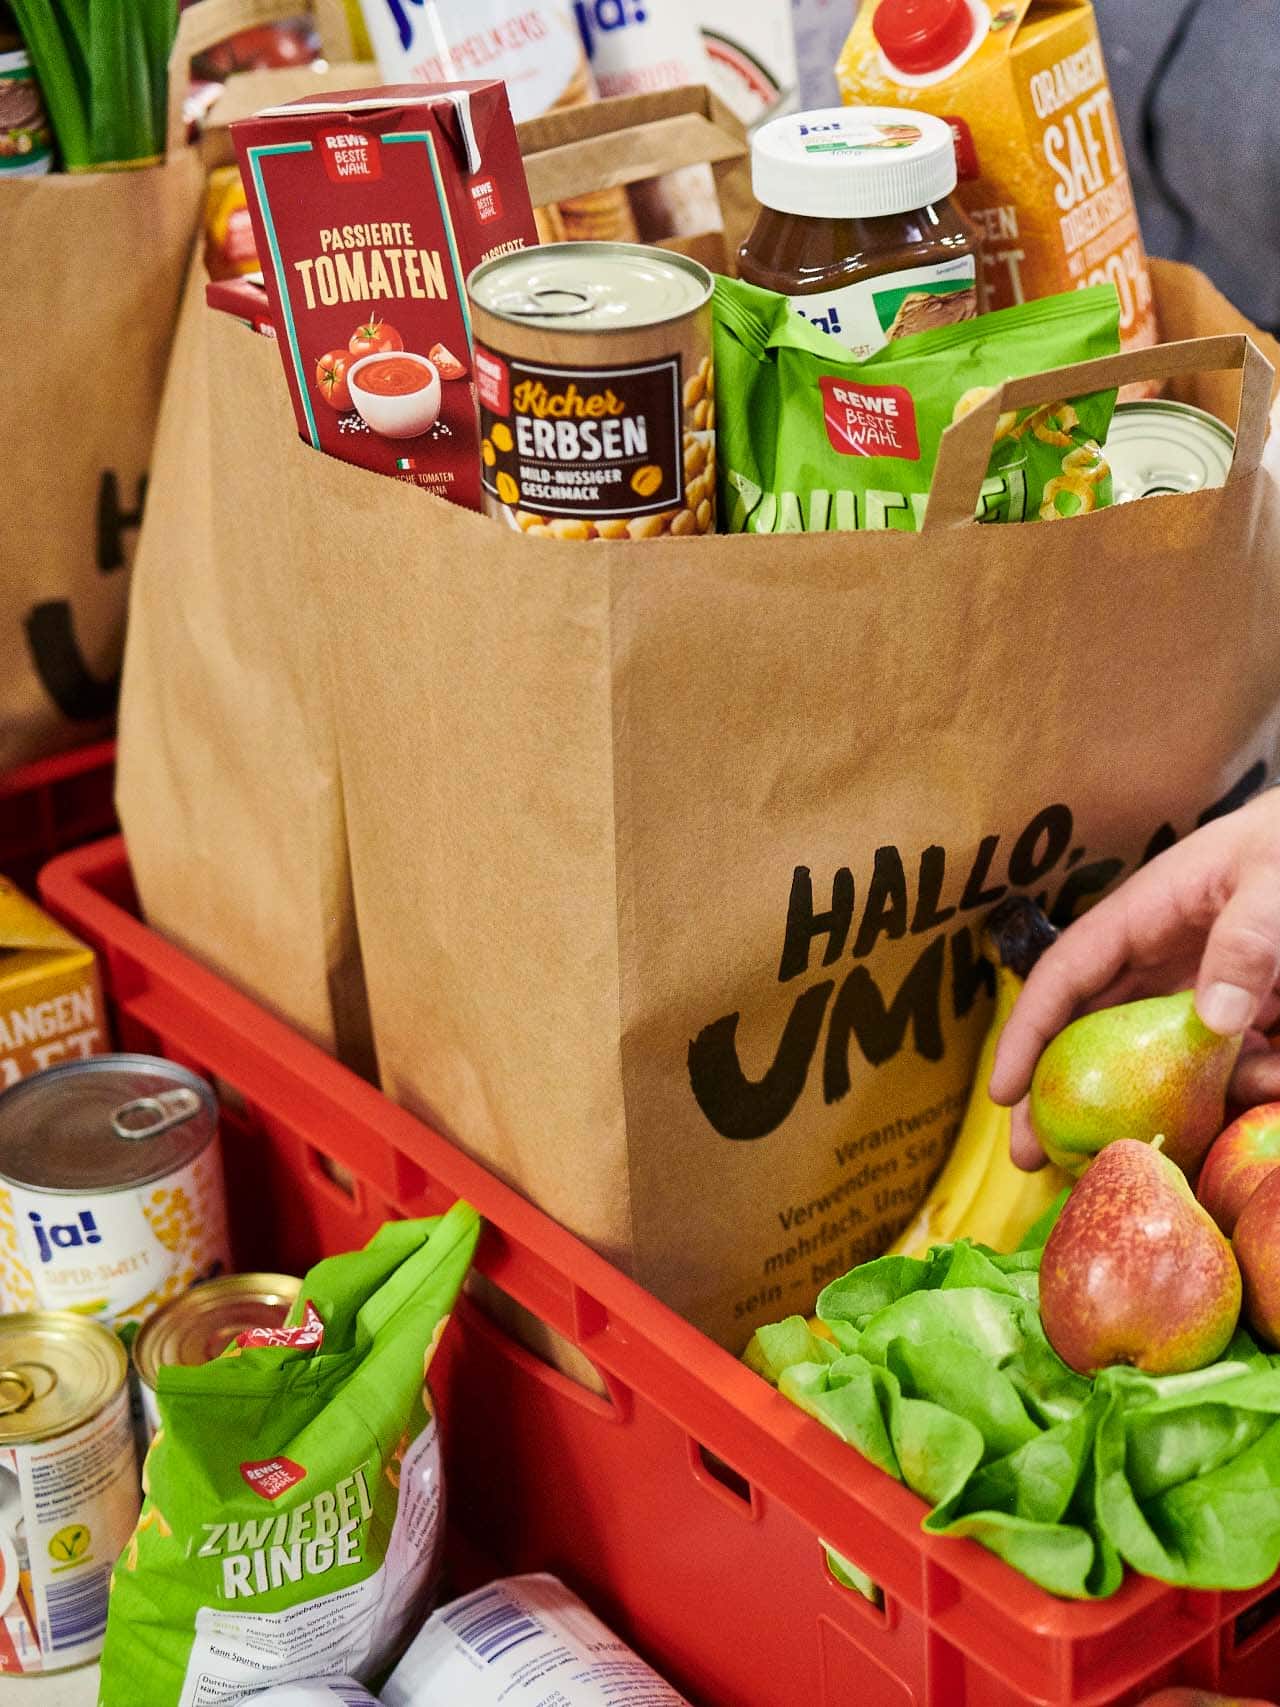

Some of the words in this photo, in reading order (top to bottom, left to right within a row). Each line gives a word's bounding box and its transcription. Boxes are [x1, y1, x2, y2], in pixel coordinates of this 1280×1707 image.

[324, 133, 369, 150] REWE
[1043, 88, 1124, 211] SAFT
[334, 149, 369, 165] BESTE
[337, 161, 371, 177] WAHL
[471, 181, 494, 200] REWE
[476, 196, 494, 211] BESTE
[479, 206, 497, 220] WAHL
[319, 222, 414, 253] PASSIERTE
[293, 249, 449, 310] TOMATEN
[512, 379, 626, 419] Kicher
[832, 386, 900, 418] REWE
[845, 407, 897, 436] BESTE
[846, 423, 903, 449] WAHL
[514, 415, 649, 462] ERBSEN
[417, 471, 455, 484] TOMATEN
[520, 481, 601, 502] GESCHMACK
[778, 1156, 899, 1232] Verwenden
[28, 1210, 103, 1264] ja!
[763, 1203, 869, 1277] mehrfach.
[732, 1282, 783, 1320] sein
[246, 1461, 283, 1481] REWE
[264, 1475, 297, 1496] WAHL
[197, 1468, 374, 1558] ZWIEBEL
[221, 1520, 363, 1600] RINGE
[209, 1644, 231, 1659] Kann
[231, 1651, 261, 1670] Spuren
